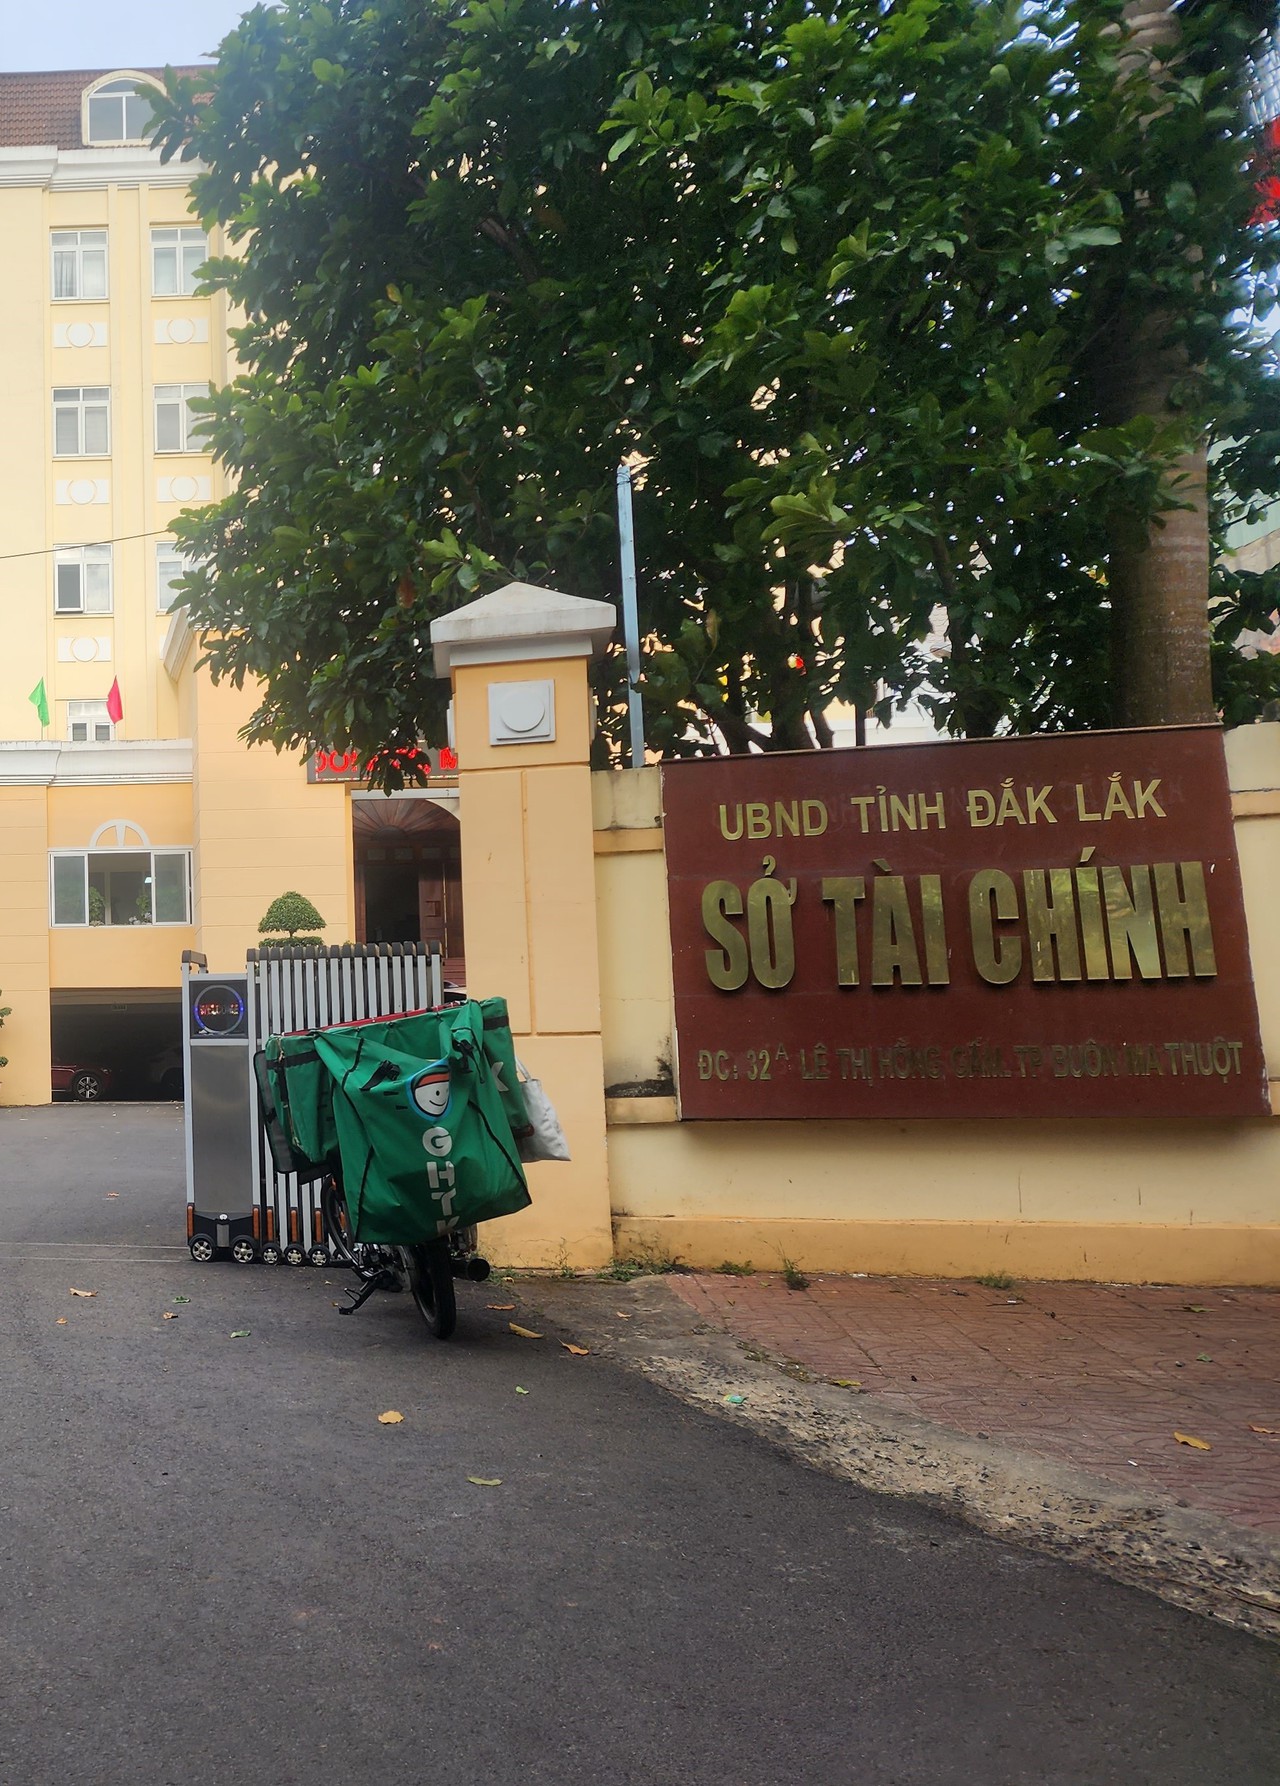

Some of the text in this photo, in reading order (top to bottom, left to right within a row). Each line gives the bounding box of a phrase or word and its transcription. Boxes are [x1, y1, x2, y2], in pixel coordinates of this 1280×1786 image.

[719, 771, 1168, 841] UBND TỈNH ĐẮK LẮK
[701, 846, 1218, 991] SỞ TÀI CHÍNH
[799, 1042, 830, 1080] LÊ
[1051, 1038, 1120, 1079] BUÔN
[1163, 1035, 1244, 1085] THUỘT
